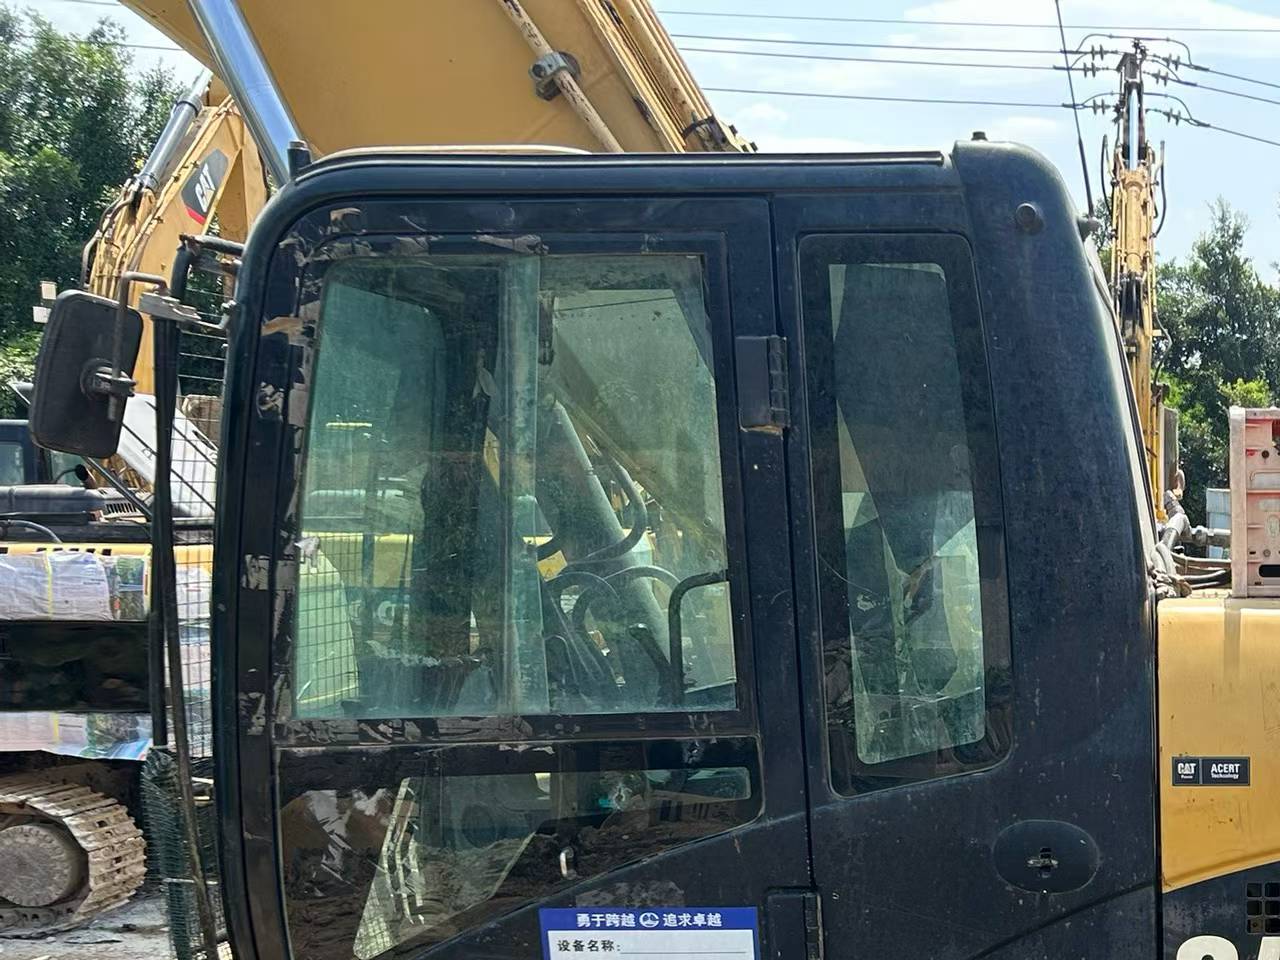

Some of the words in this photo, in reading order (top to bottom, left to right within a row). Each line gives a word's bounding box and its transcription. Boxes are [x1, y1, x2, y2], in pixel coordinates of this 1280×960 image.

[194, 162, 217, 213] CAT
[1177, 762, 1197, 774] CAT
[1210, 763, 1241, 773] ACERT
[576, 913, 636, 928] 勇于跨越
[663, 912, 723, 927] 追求卓越
